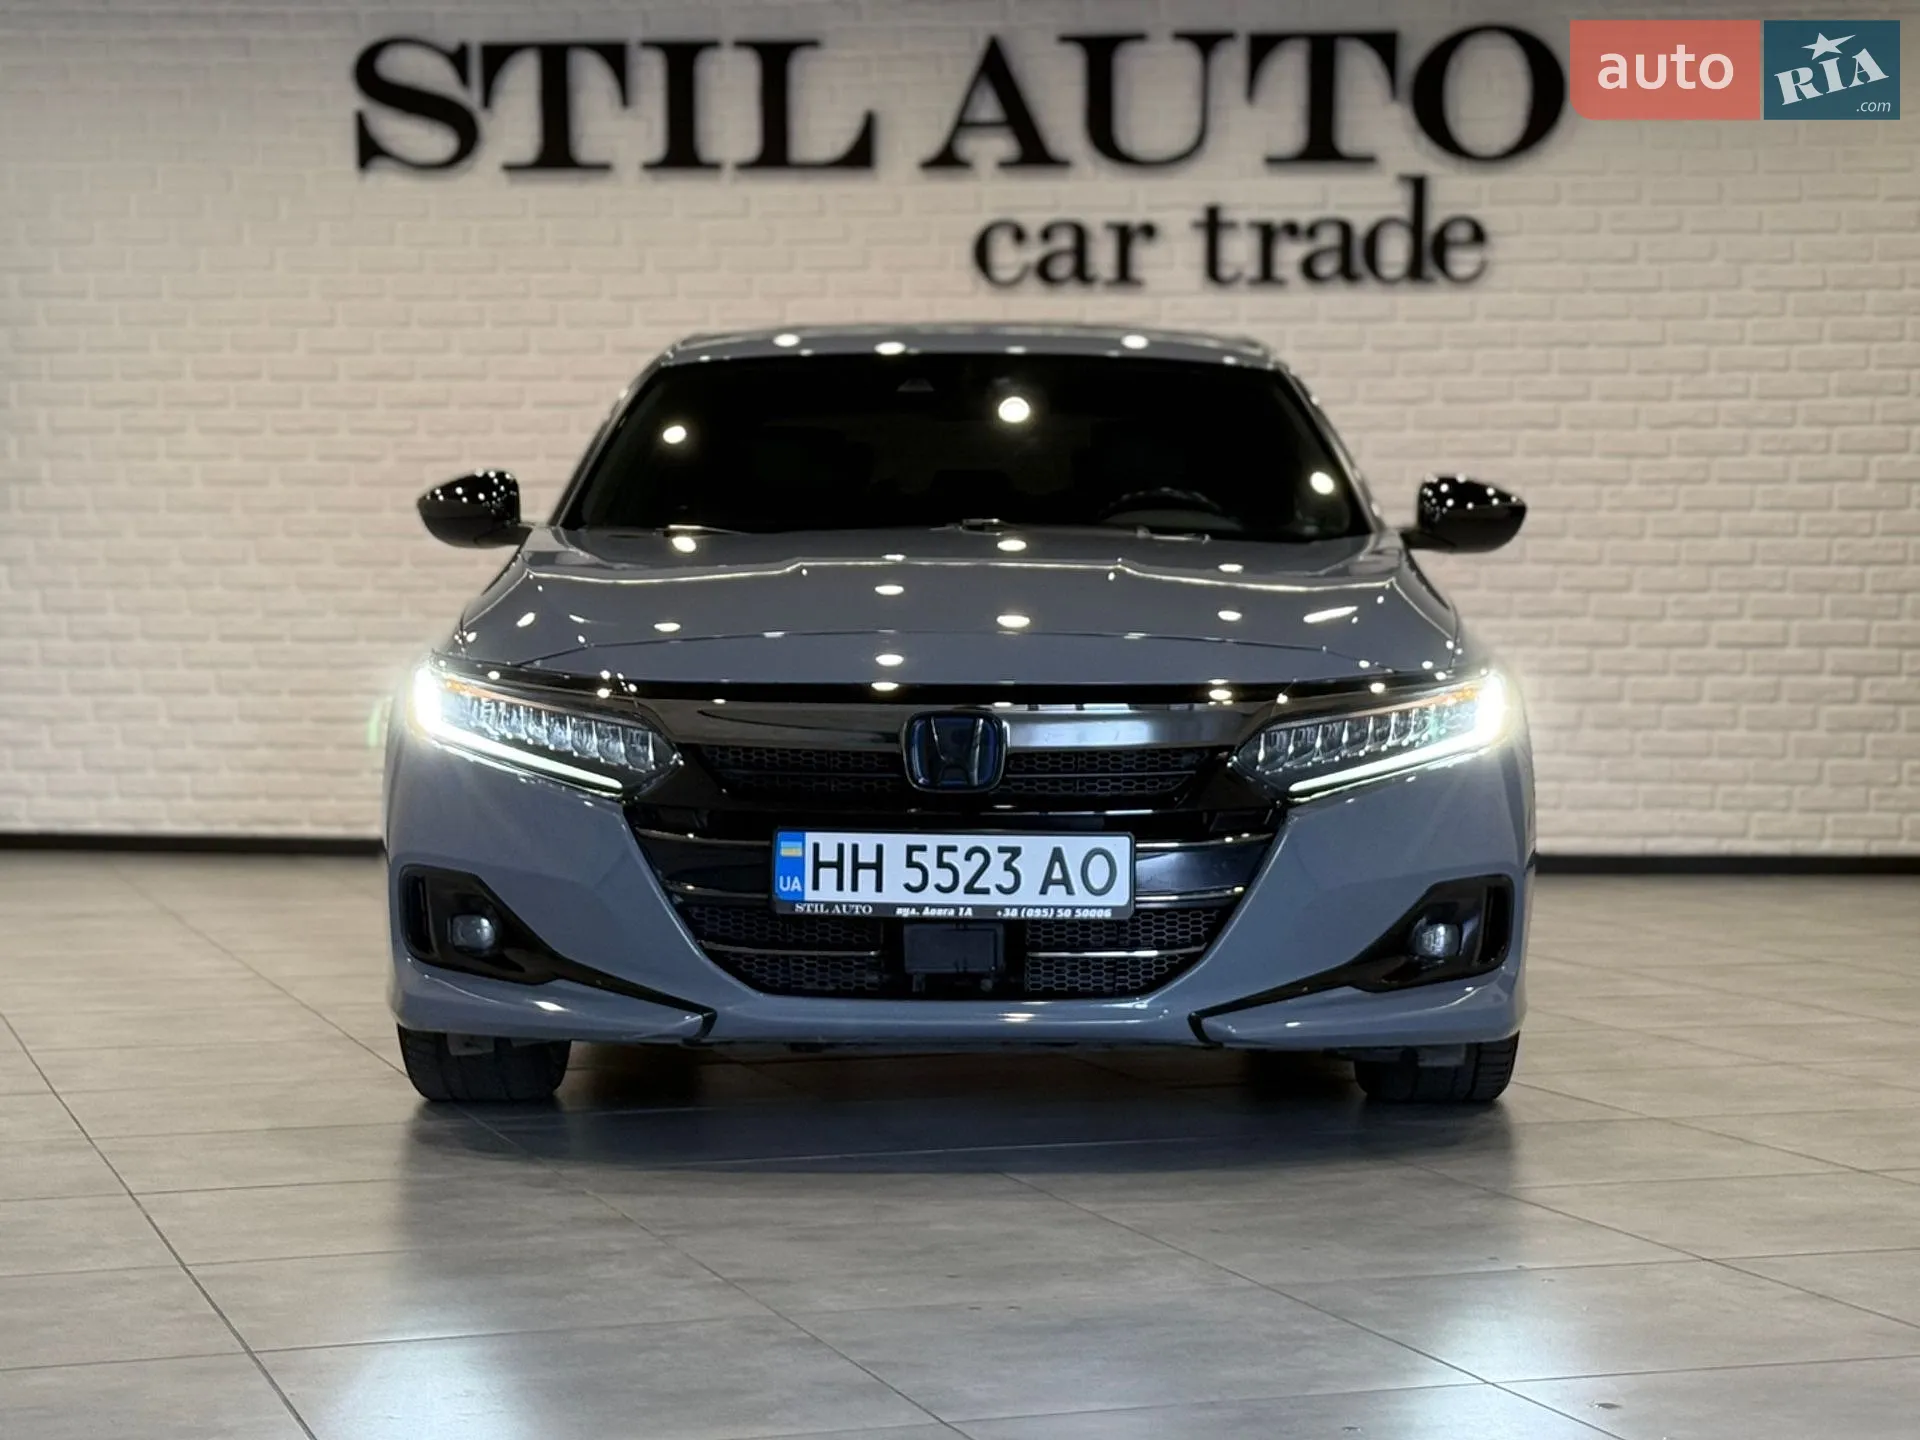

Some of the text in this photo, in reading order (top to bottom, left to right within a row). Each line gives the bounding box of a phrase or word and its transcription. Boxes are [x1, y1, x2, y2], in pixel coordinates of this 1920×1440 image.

[353, 24, 1567, 172] STIL AUTO
[973, 174, 1488, 288] car trade
[779, 875, 803, 892] UA
[811, 842, 1118, 897] HH 5523 AO
[794, 903, 873, 915] STIL AUTO
